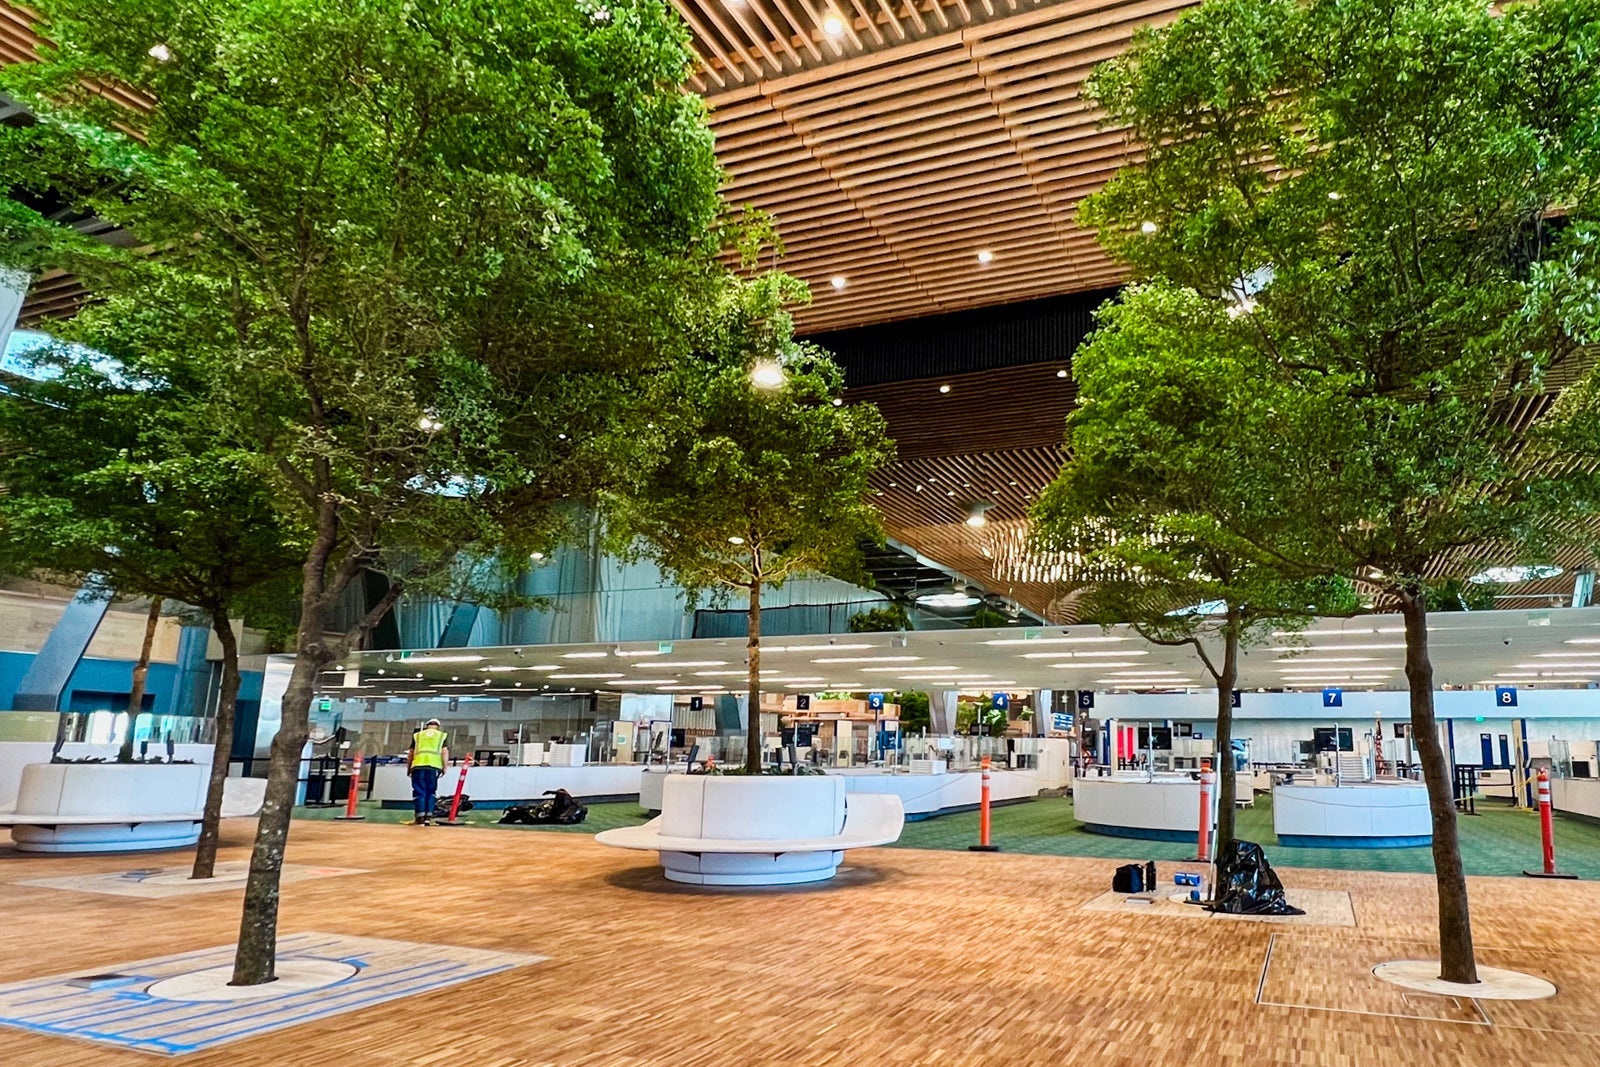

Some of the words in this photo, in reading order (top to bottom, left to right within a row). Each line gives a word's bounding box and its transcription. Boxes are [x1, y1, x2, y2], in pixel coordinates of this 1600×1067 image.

[872, 697, 879, 707] 3
[997, 696, 1003, 706] 4
[1083, 695, 1090, 705] 5
[1328, 693, 1336, 703] 7
[1502, 692, 1512, 703] 8
[800, 699, 806, 708] 2
